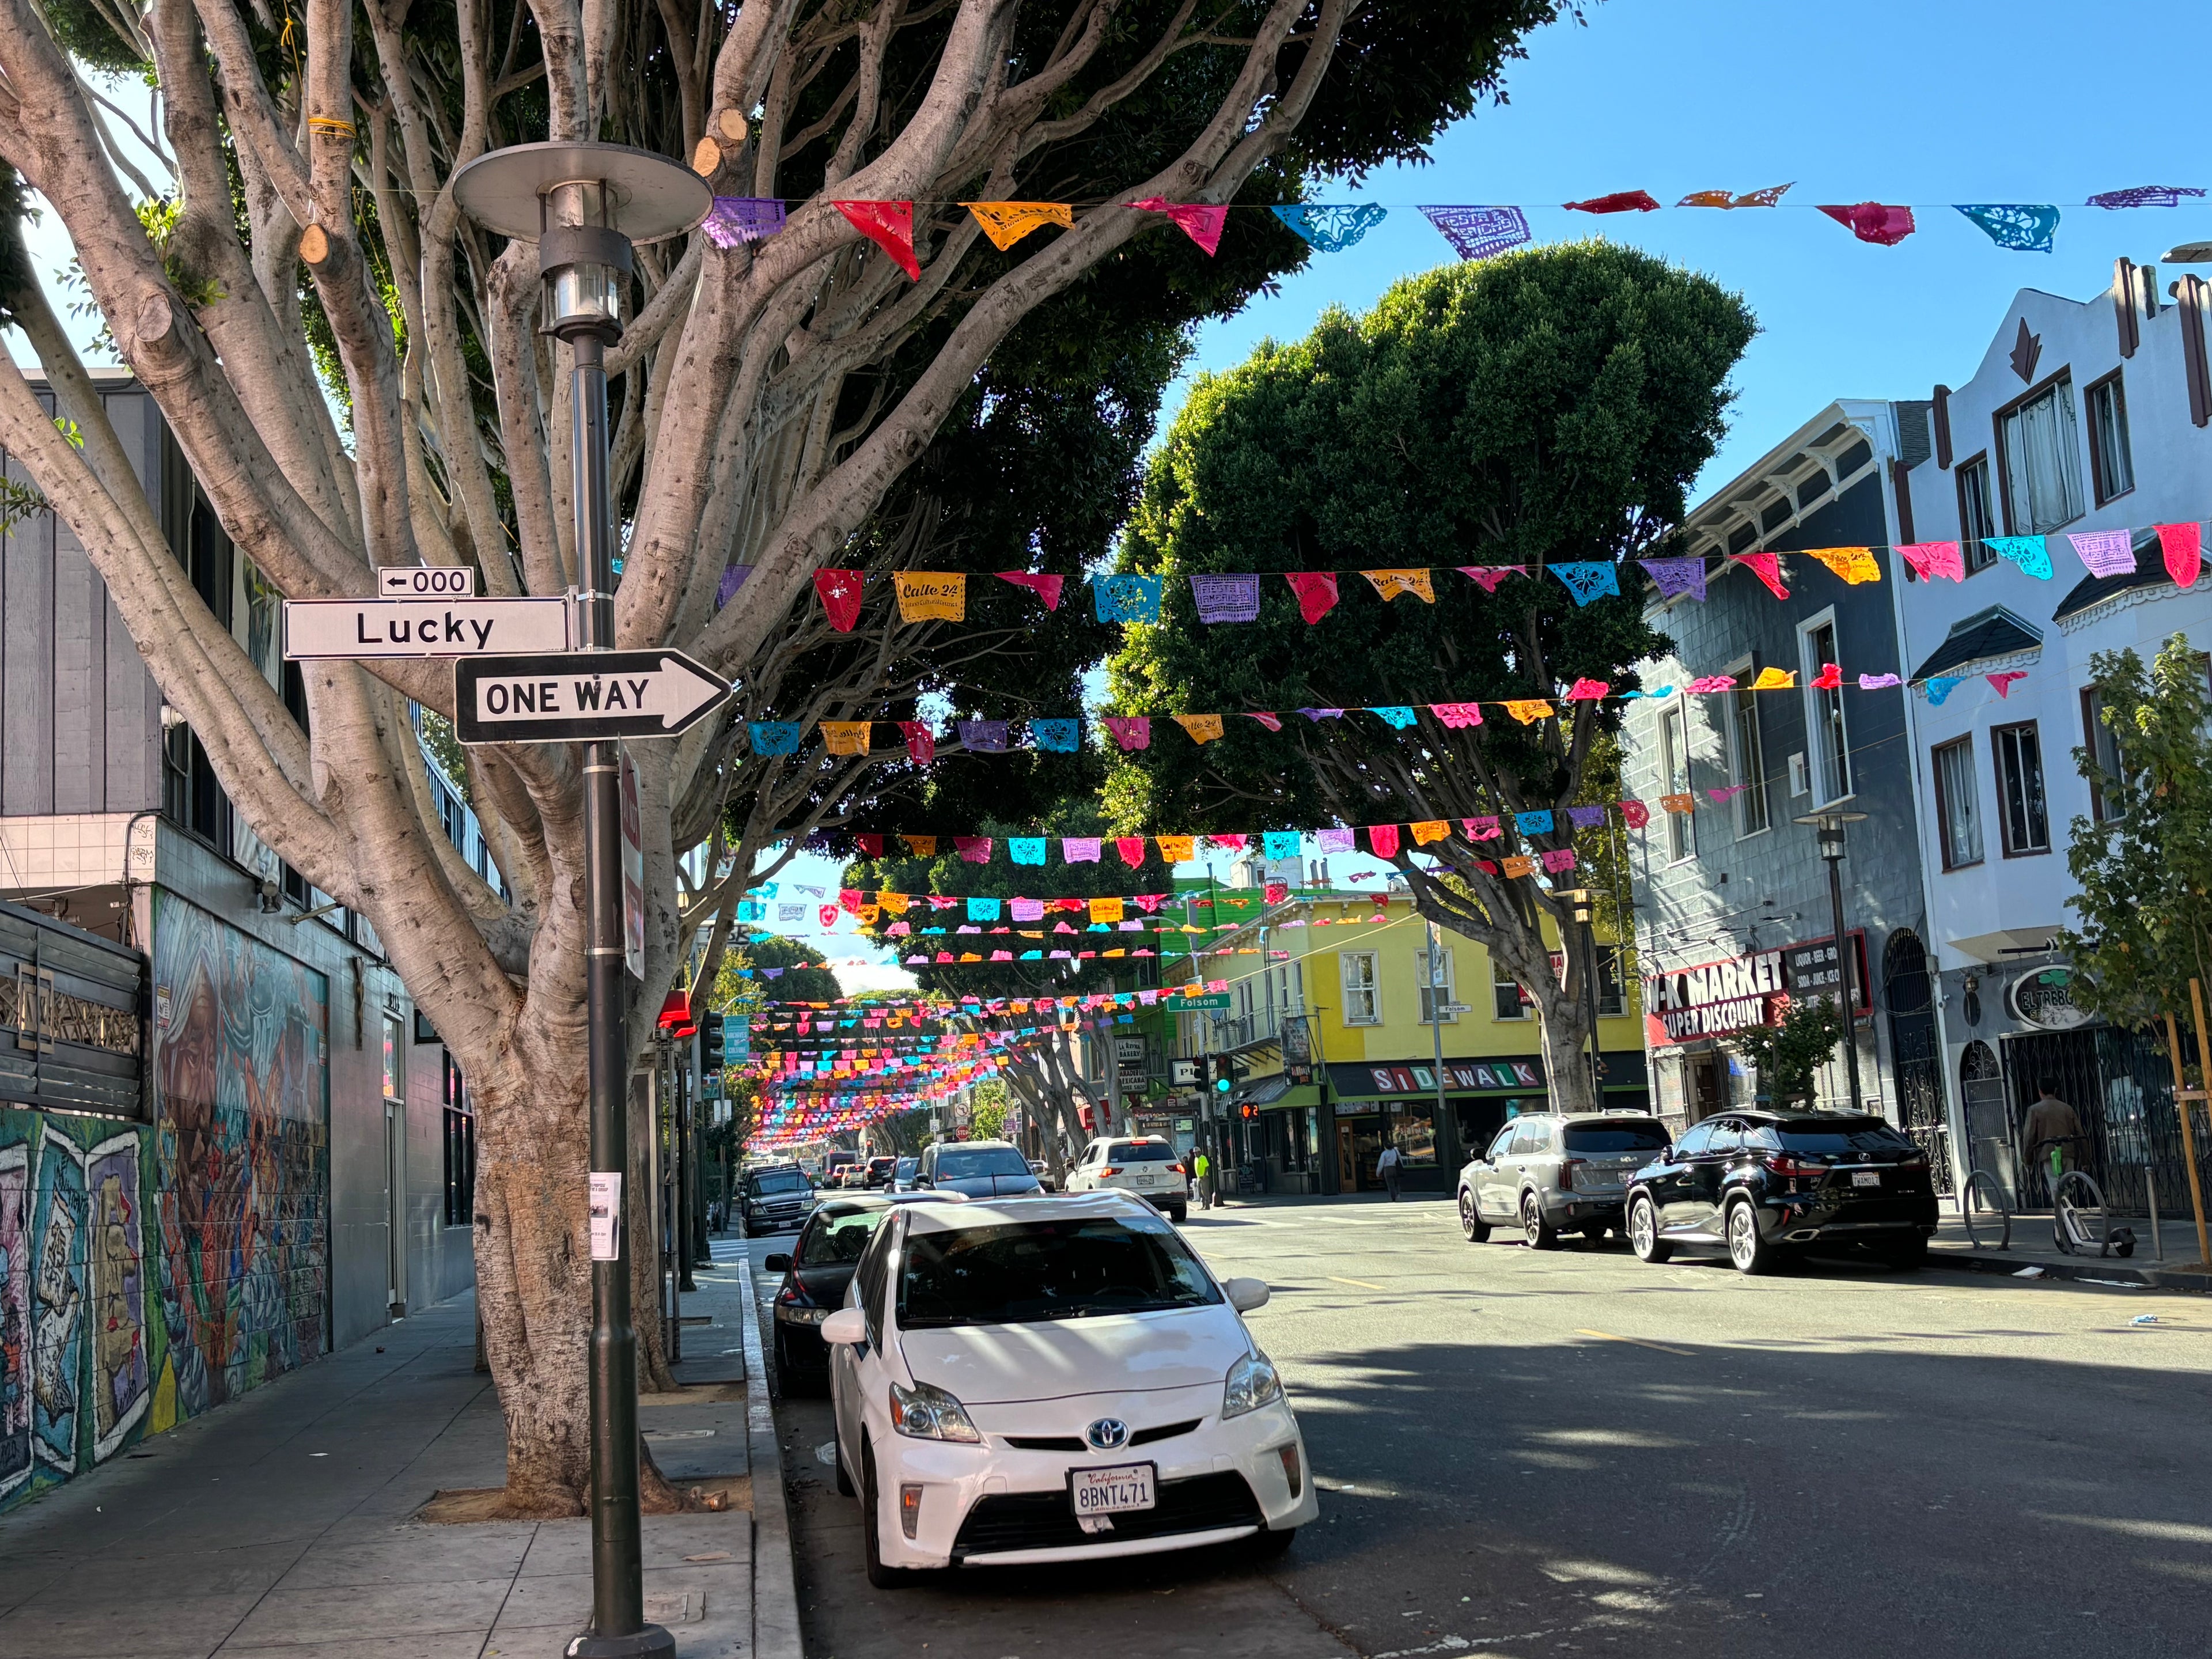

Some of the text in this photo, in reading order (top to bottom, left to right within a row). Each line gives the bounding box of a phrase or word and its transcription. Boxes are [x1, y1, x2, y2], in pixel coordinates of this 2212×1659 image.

[413, 571, 465, 592] 000
[903, 584, 957, 598] Calle 24
[357, 611, 495, 650] Lucky
[486, 678, 650, 715] ONE WAY
[1795, 952, 1812, 967] LIQUOR
[1813, 949, 1825, 963] BEER
[1687, 950, 1782, 1007] MARKET
[1797, 974, 1810, 988] SODA
[1813, 971, 1825, 986] JUICE
[1180, 998, 1218, 1007] Folsom
[2021, 989, 2076, 1009] EL TREBO
[1662, 997, 1764, 1039] SUPER DISCOUNT
[1373, 1065, 1535, 1090] SIDEWALK
[1089, 1472, 1135, 1485] California
[1079, 1482, 1149, 1508] 8BNT471
